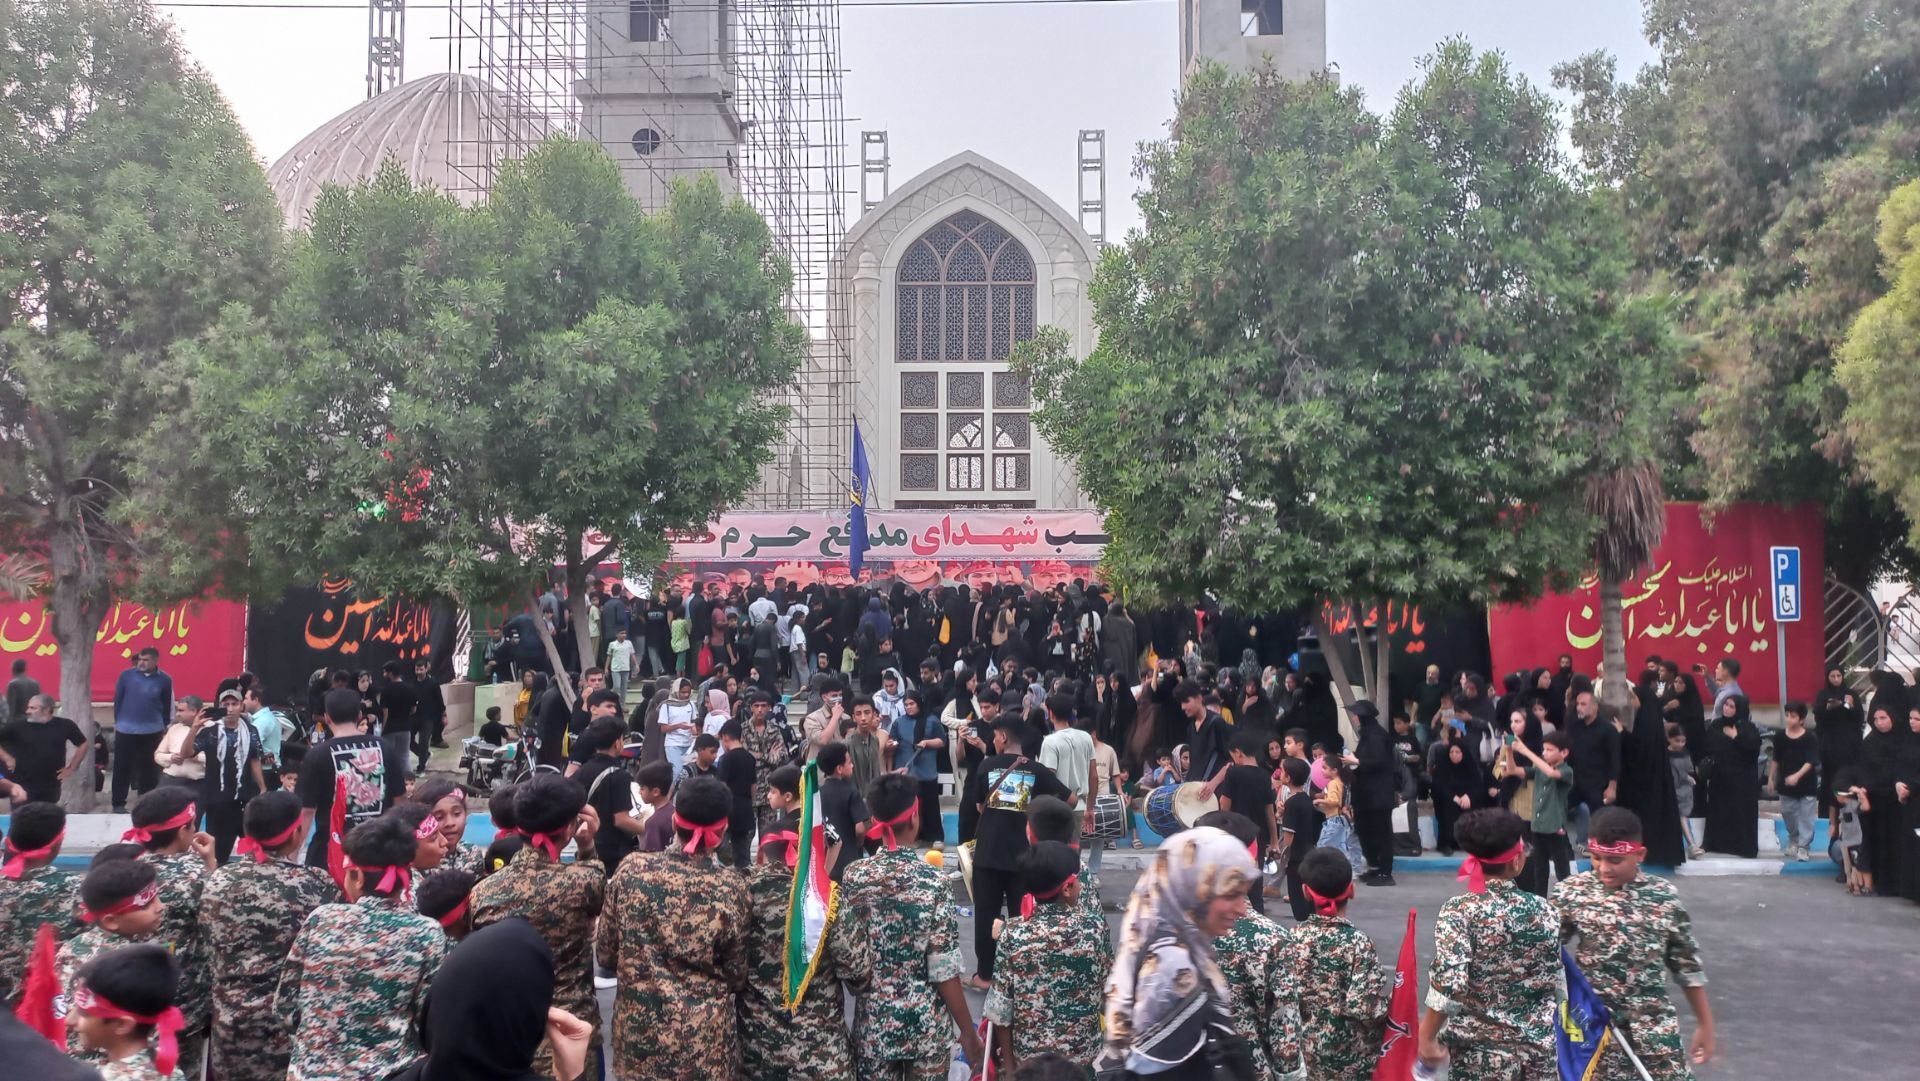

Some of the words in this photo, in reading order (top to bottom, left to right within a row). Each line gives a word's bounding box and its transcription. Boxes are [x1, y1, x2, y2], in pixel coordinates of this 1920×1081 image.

[720, 525, 811, 558] حرم
[819, 513, 908, 558] مدفع
[911, 513, 1038, 556] شهدای
[1777, 553, 1789, 580] P
